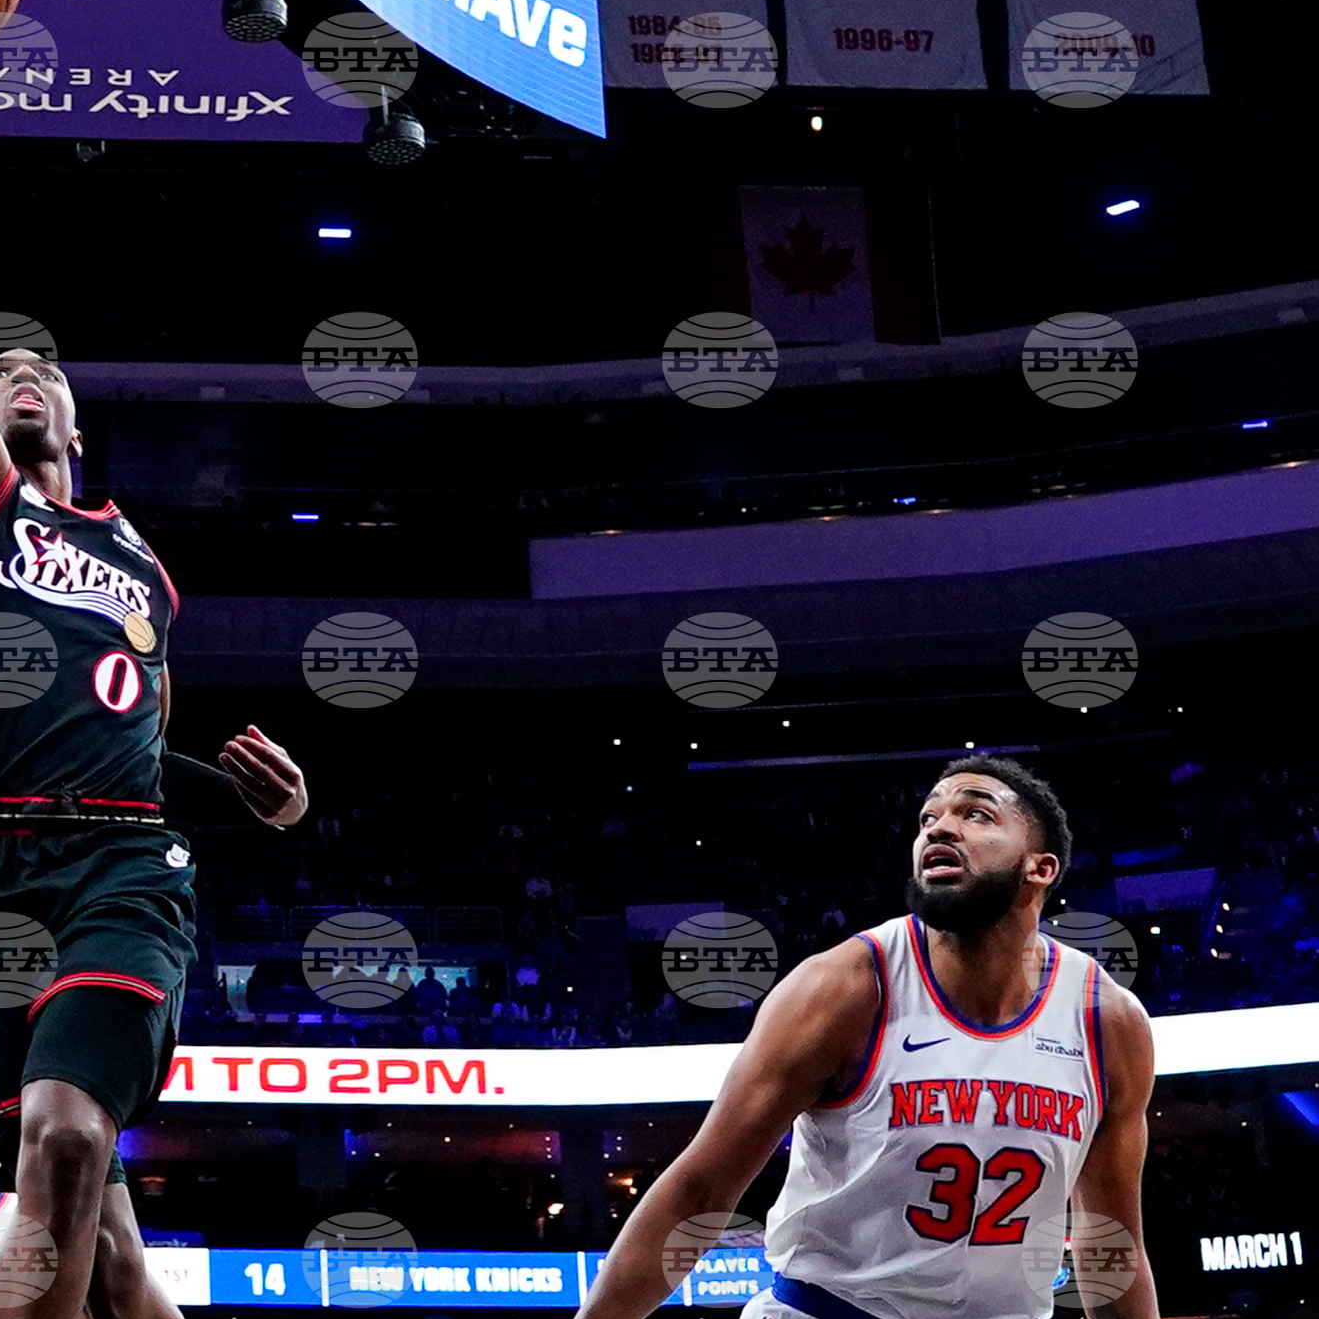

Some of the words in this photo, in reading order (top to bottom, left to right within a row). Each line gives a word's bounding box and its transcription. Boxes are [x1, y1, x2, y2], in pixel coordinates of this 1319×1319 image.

[833, 27, 935, 54] 1996-97
[93, 651, 142, 713] 0
[208, 1057, 308, 1094] TO
[328, 1058, 506, 1096] 2PM.
[888, 1079, 983, 1130] NEW
[988, 1079, 1084, 1143] YORK
[905, 1142, 1046, 1247] 32
[694, 1257, 760, 1274] PLAYER
[1200, 1233, 1285, 1271] MARCH
[1289, 1232, 1303, 1265] 1
[244, 1263, 287, 1295] 14
[349, 1266, 403, 1292] NEW
[409, 1266, 470, 1293] YORK
[474, 1267, 563, 1294] KNICKS
[698, 1281, 758, 1296] POINTS
